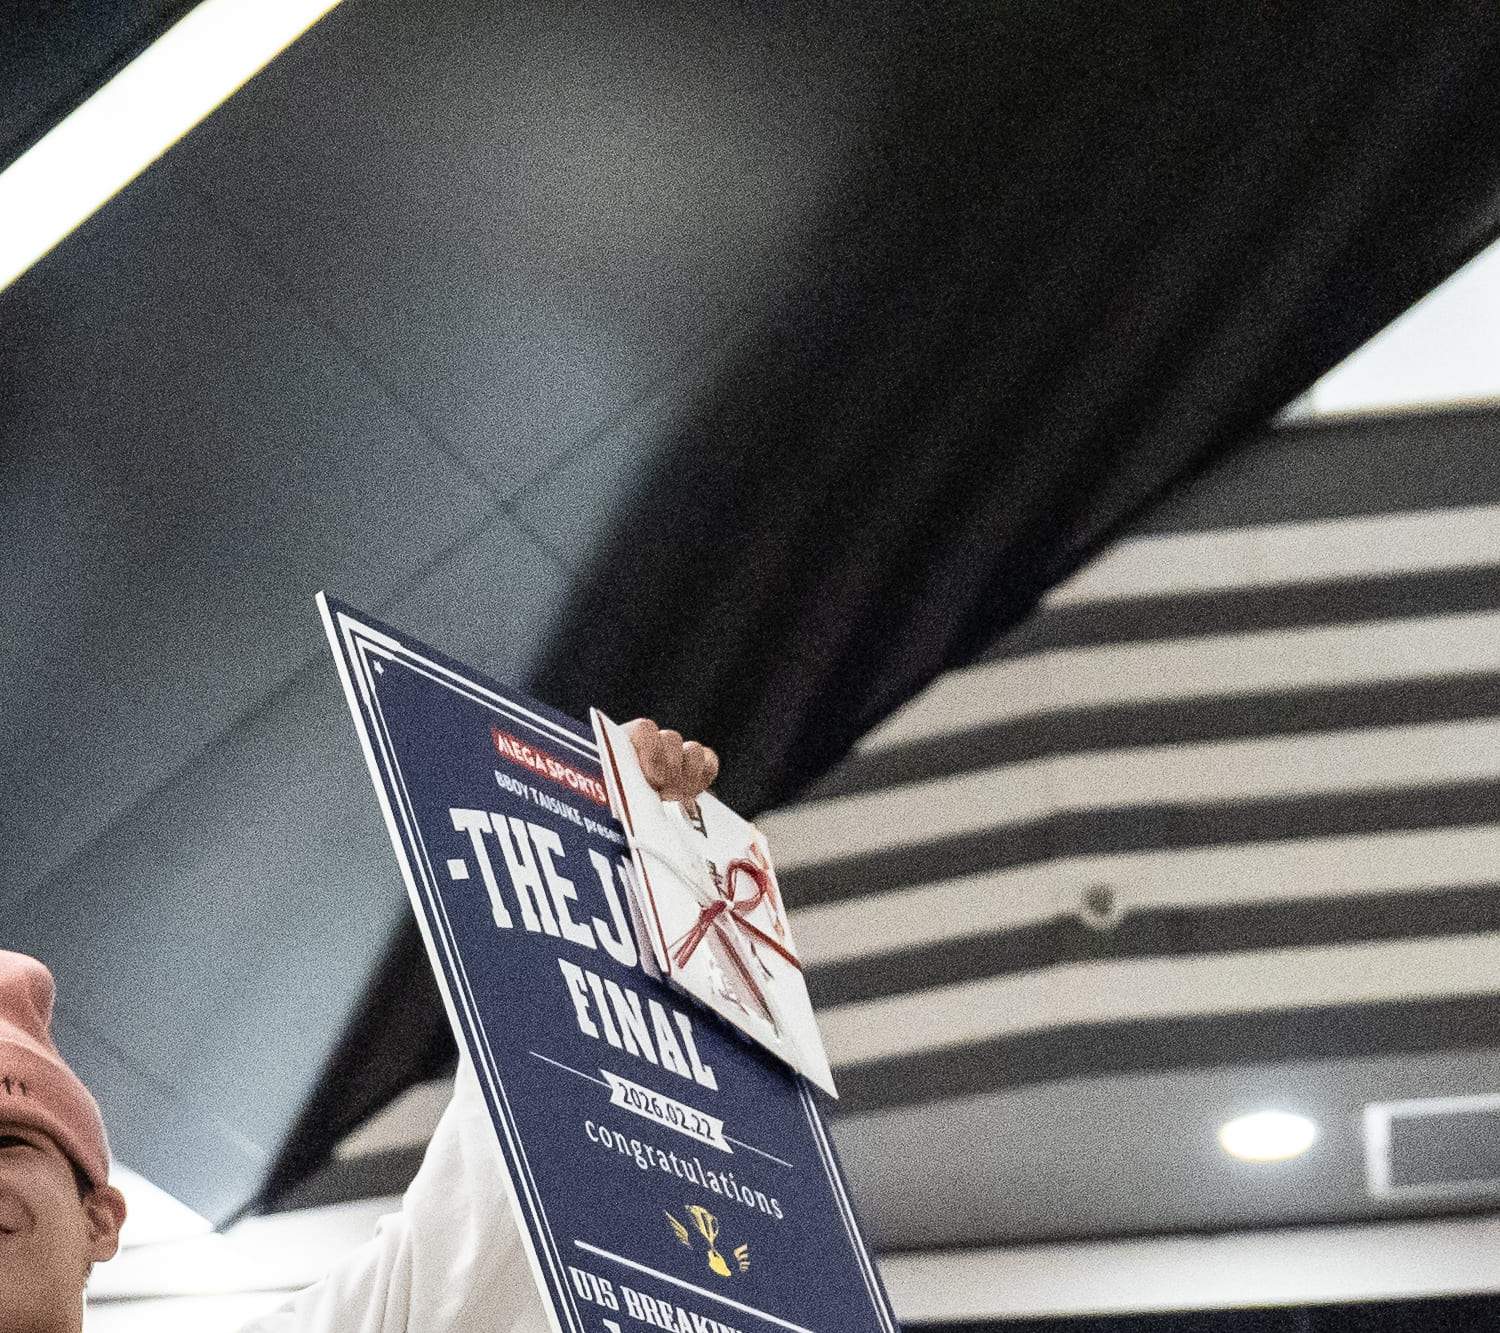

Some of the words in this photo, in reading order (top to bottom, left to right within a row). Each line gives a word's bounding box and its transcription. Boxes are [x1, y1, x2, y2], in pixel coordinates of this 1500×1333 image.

[494, 769, 529, 801] BBOY
[529, 786, 585, 826] TAISUKE
[498, 733, 607, 805] MEGASPORTS
[447, 807, 597, 950] -THE
[557, 957, 719, 1092] FINAL
[618, 1081, 717, 1140] 2026.02.22
[584, 1119, 785, 1220] congratulations
[568, 1265, 621, 1312] U15
